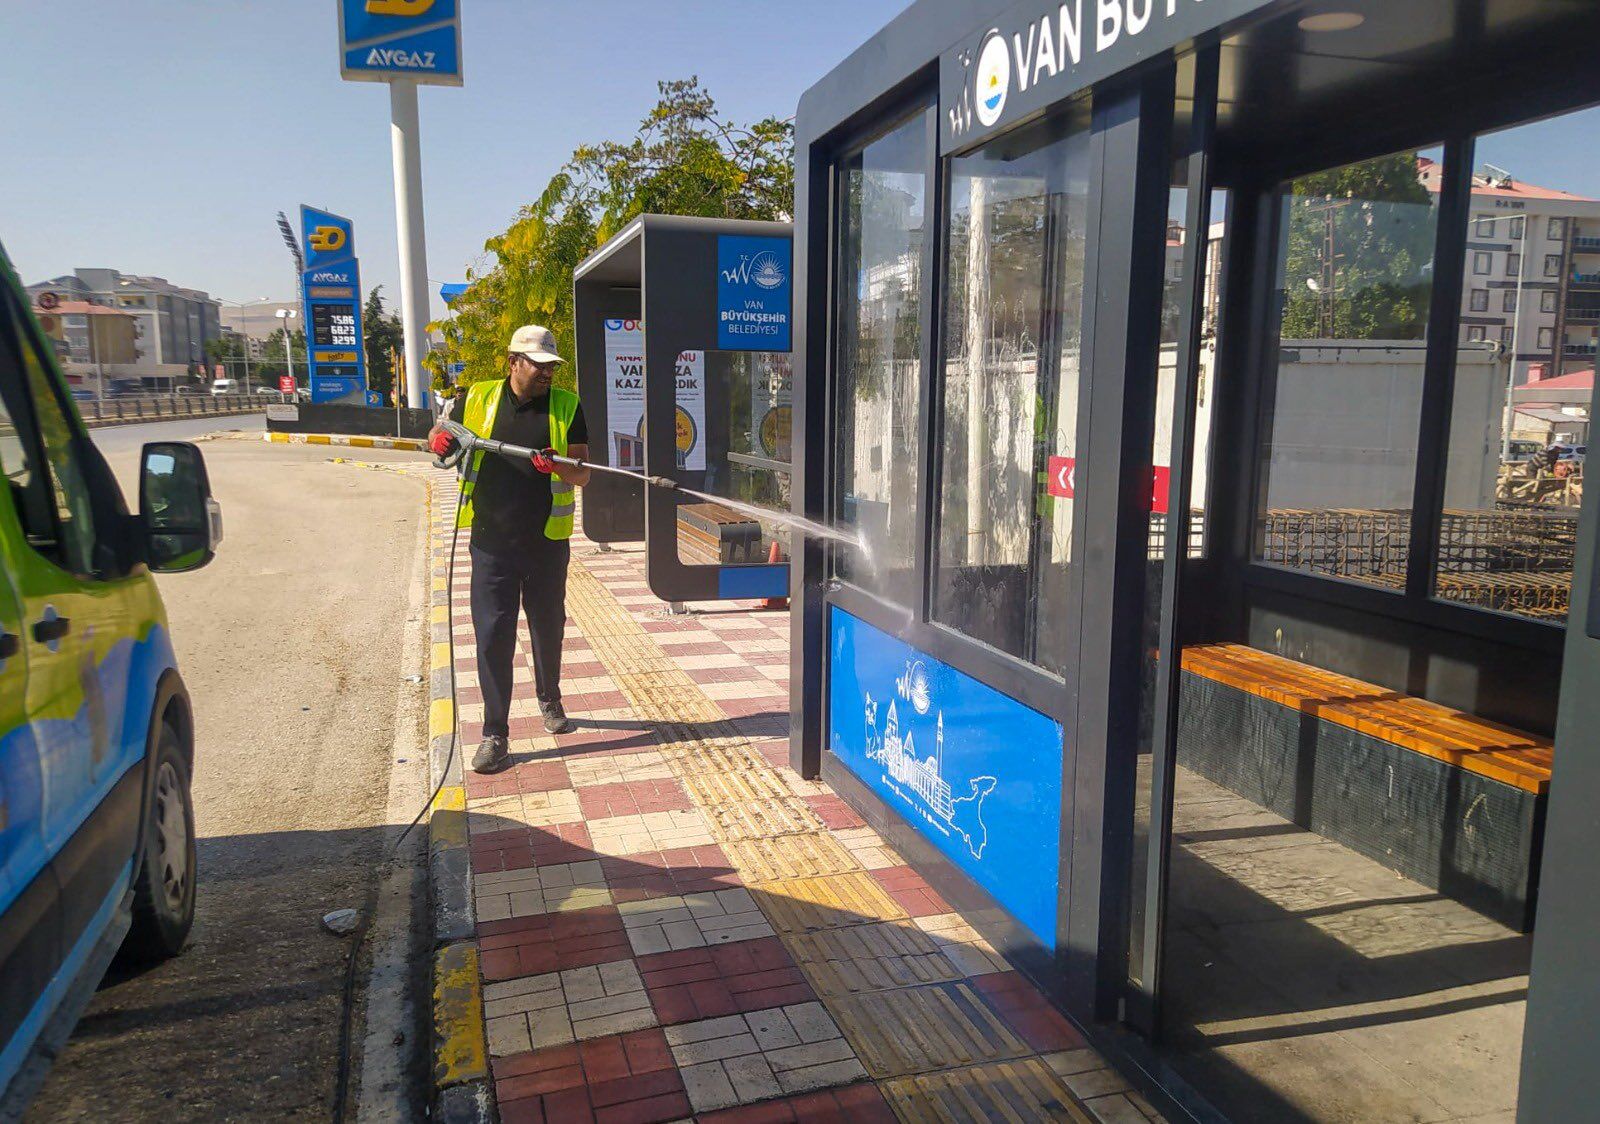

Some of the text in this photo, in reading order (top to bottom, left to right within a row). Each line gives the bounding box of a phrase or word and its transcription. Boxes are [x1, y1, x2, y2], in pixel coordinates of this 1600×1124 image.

[1013, 0, 1082, 93] VAN
[366, 48, 436, 68] AYGAZ
[311, 273, 349, 283] AYGAZ
[744, 300, 764, 310] VAN
[721, 310, 786, 325] BÜYÜKŞEHİR
[728, 322, 779, 335] BELEDİYESİ
